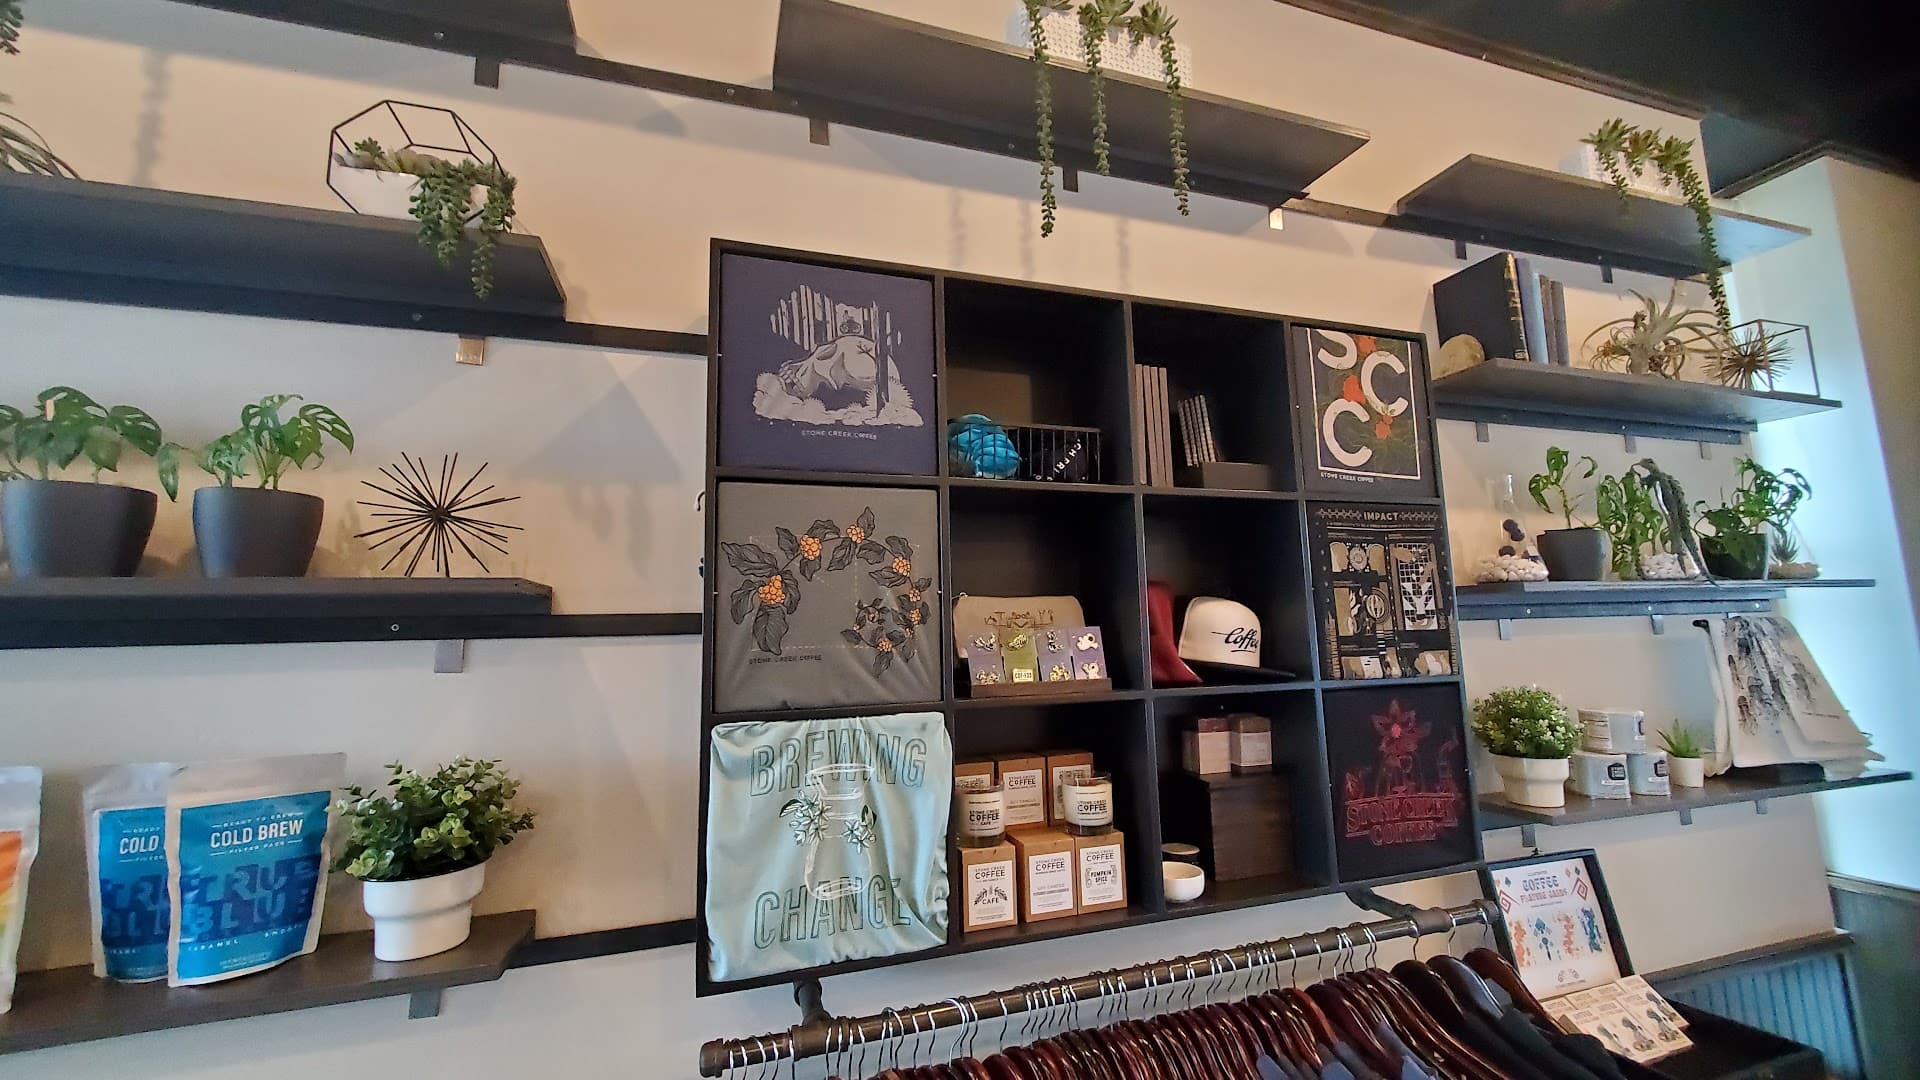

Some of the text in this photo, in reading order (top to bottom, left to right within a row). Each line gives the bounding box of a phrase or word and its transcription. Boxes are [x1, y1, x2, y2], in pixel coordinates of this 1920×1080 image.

[1361, 351, 1409, 417] C
[1322, 398, 1372, 467] C
[1363, 511, 1399, 521] IMPACT
[750, 729, 927, 796] BREWING
[1008, 778, 1036, 787] COFFEE
[1077, 803, 1107, 811] COFFEE
[969, 813, 1000, 821] COFFEE
[210, 819, 303, 848] COLD BREW
[119, 835, 160, 855] COLD
[1086, 853, 1115, 862] COFFEE
[1035, 861, 1065, 871] COFFEE
[975, 870, 1006, 879] COFFEE
[754, 874, 911, 950] CHANGE
